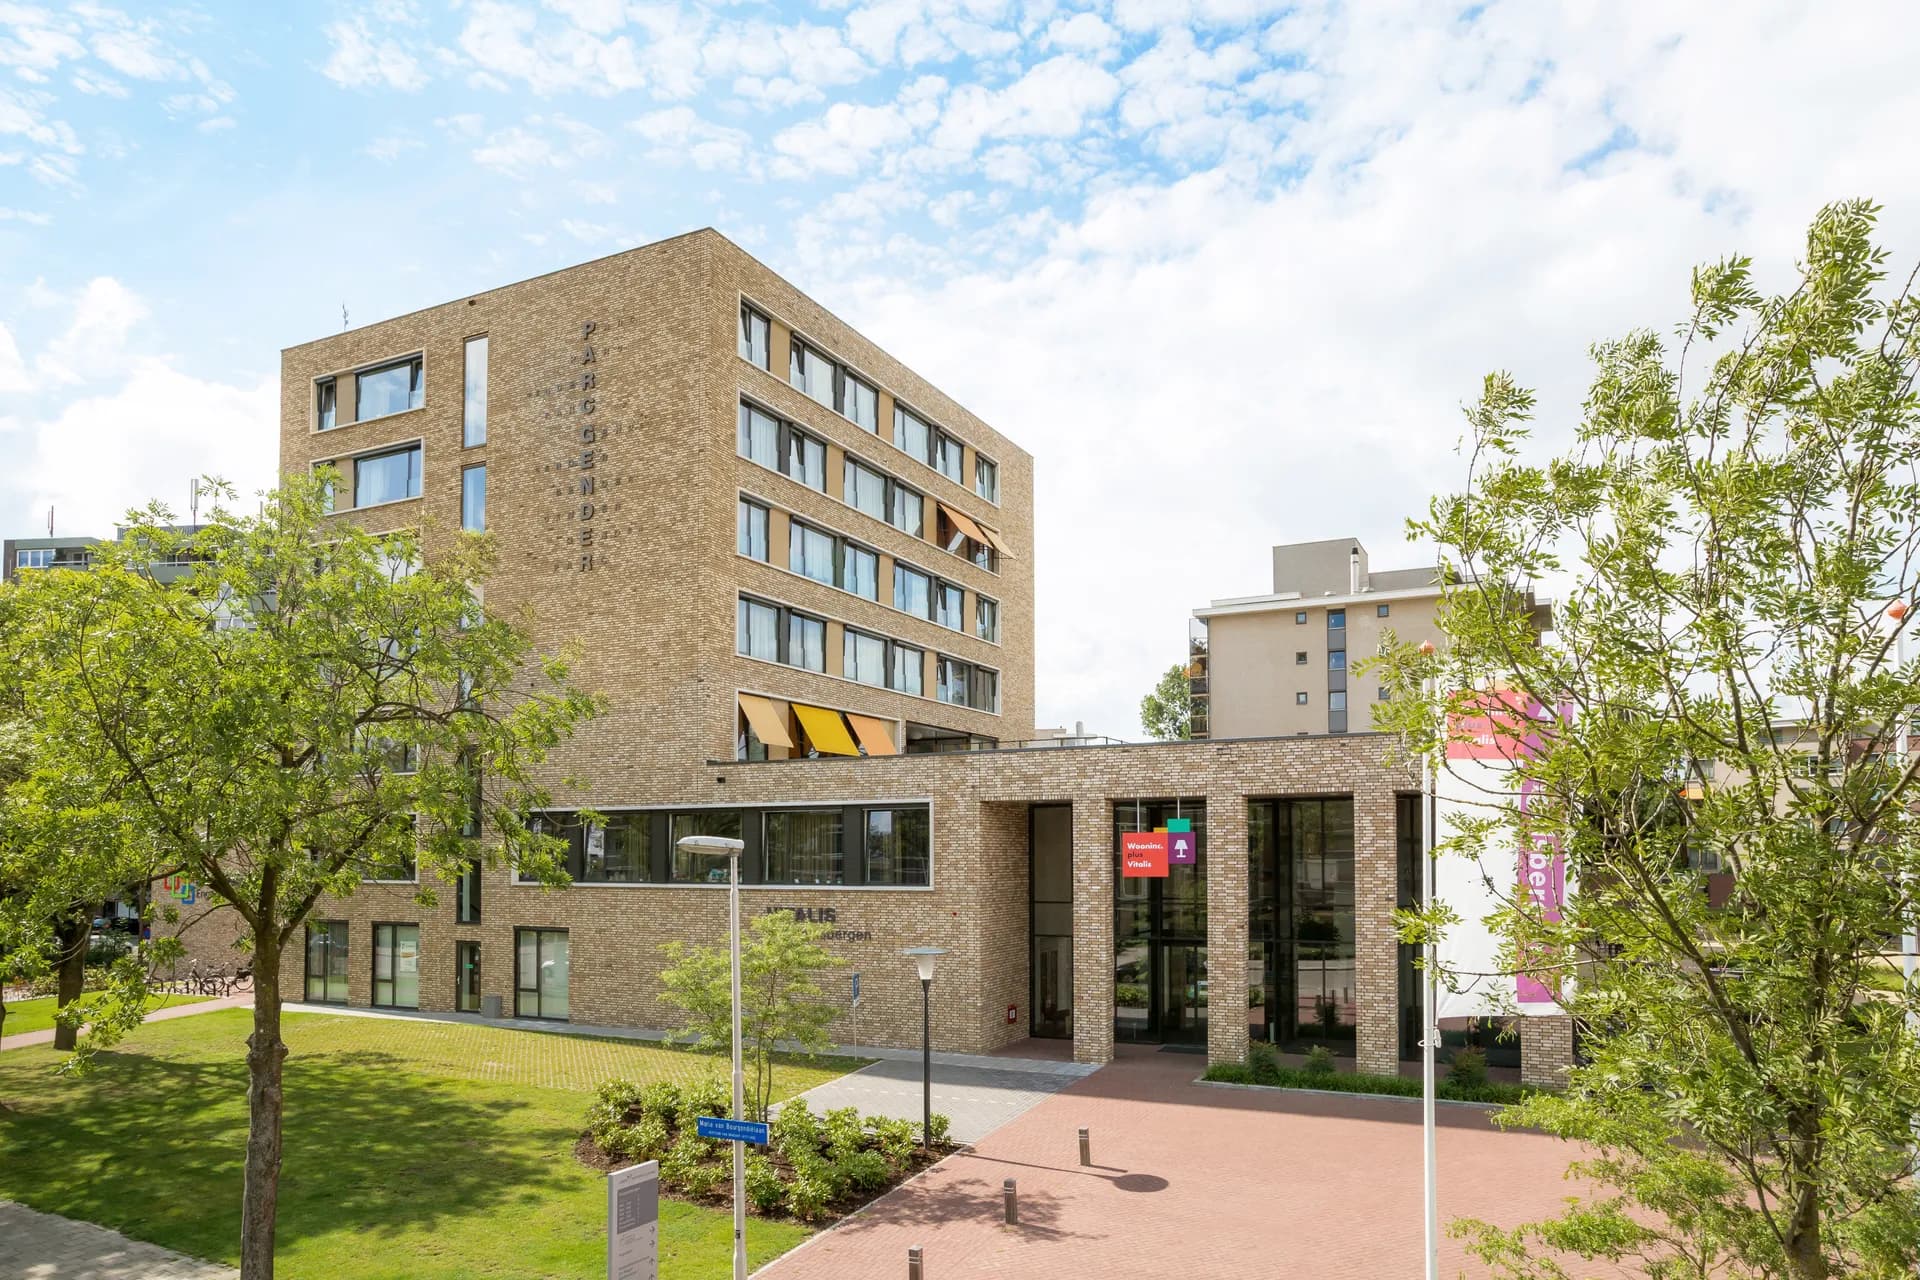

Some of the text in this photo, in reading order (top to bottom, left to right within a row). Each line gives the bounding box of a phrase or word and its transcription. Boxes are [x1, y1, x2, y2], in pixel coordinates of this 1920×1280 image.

[579, 320, 597, 573] PARCGENDER
[1127, 842, 1164, 850] Wooninc.
[1127, 851, 1144, 859] plus
[1127, 860, 1152, 868] Vitalis
[699, 1119, 714, 1128] Maria
